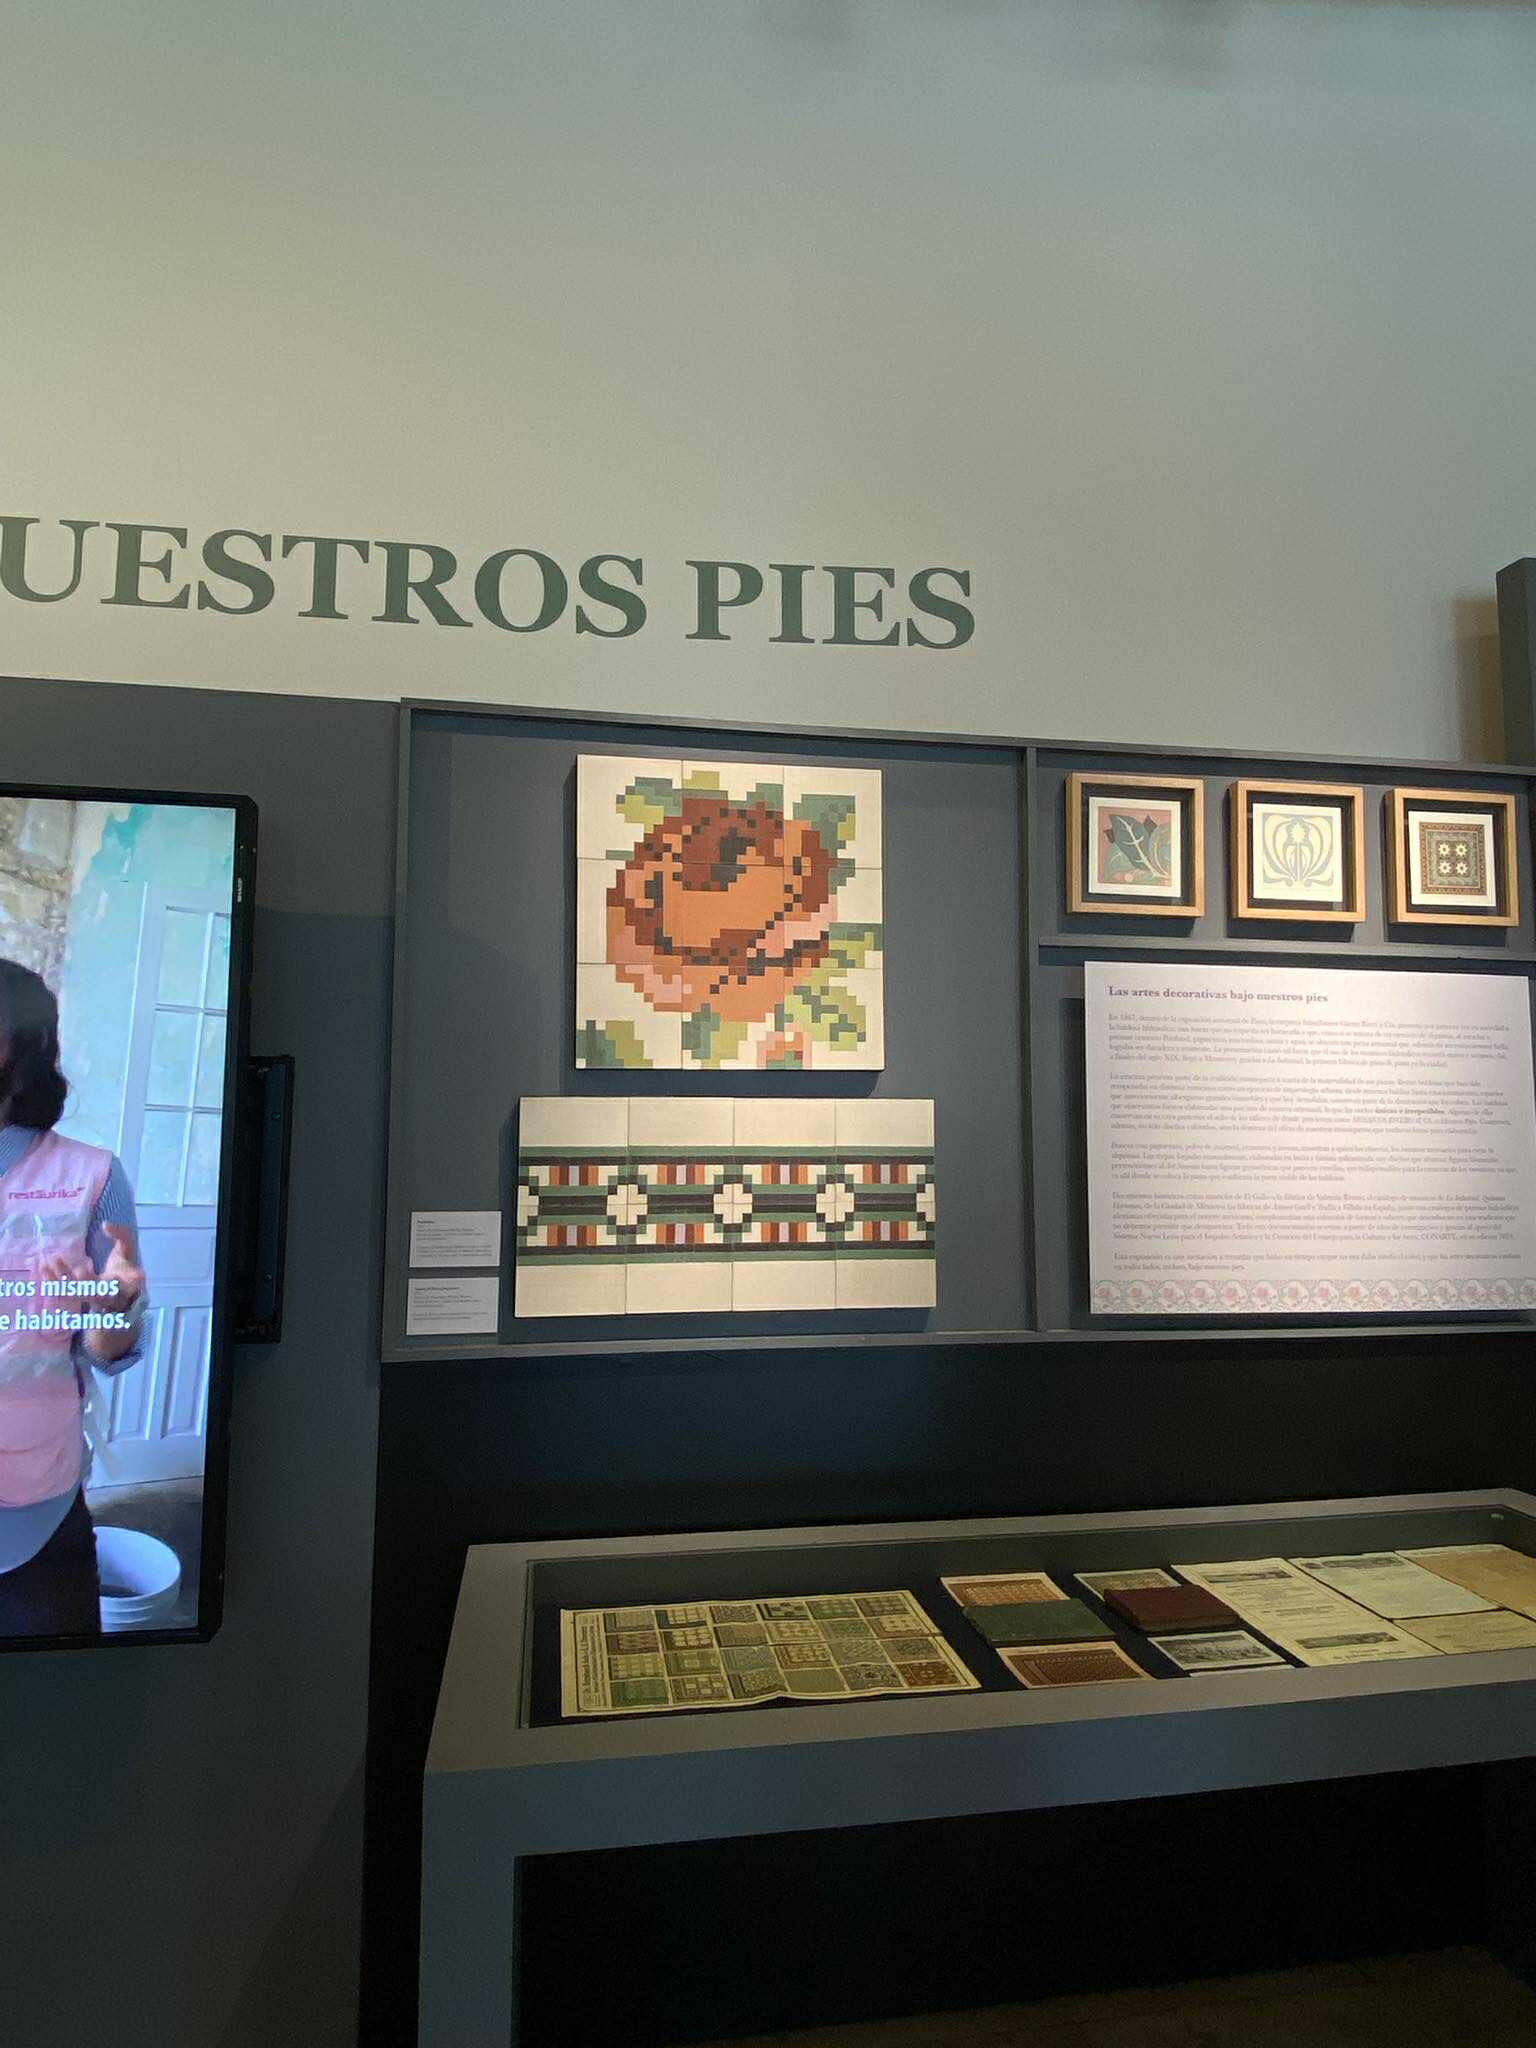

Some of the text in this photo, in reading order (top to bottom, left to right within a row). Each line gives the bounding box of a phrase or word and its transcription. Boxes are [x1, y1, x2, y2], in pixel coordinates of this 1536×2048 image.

[0, 516, 976, 650] UESTROS PIES
[1108, 986, 1328, 1004] Las artes decorativas bajo nuestros pies
[41, 1275, 120, 1297] mismos
[15, 1308, 131, 1330] habitamos.
